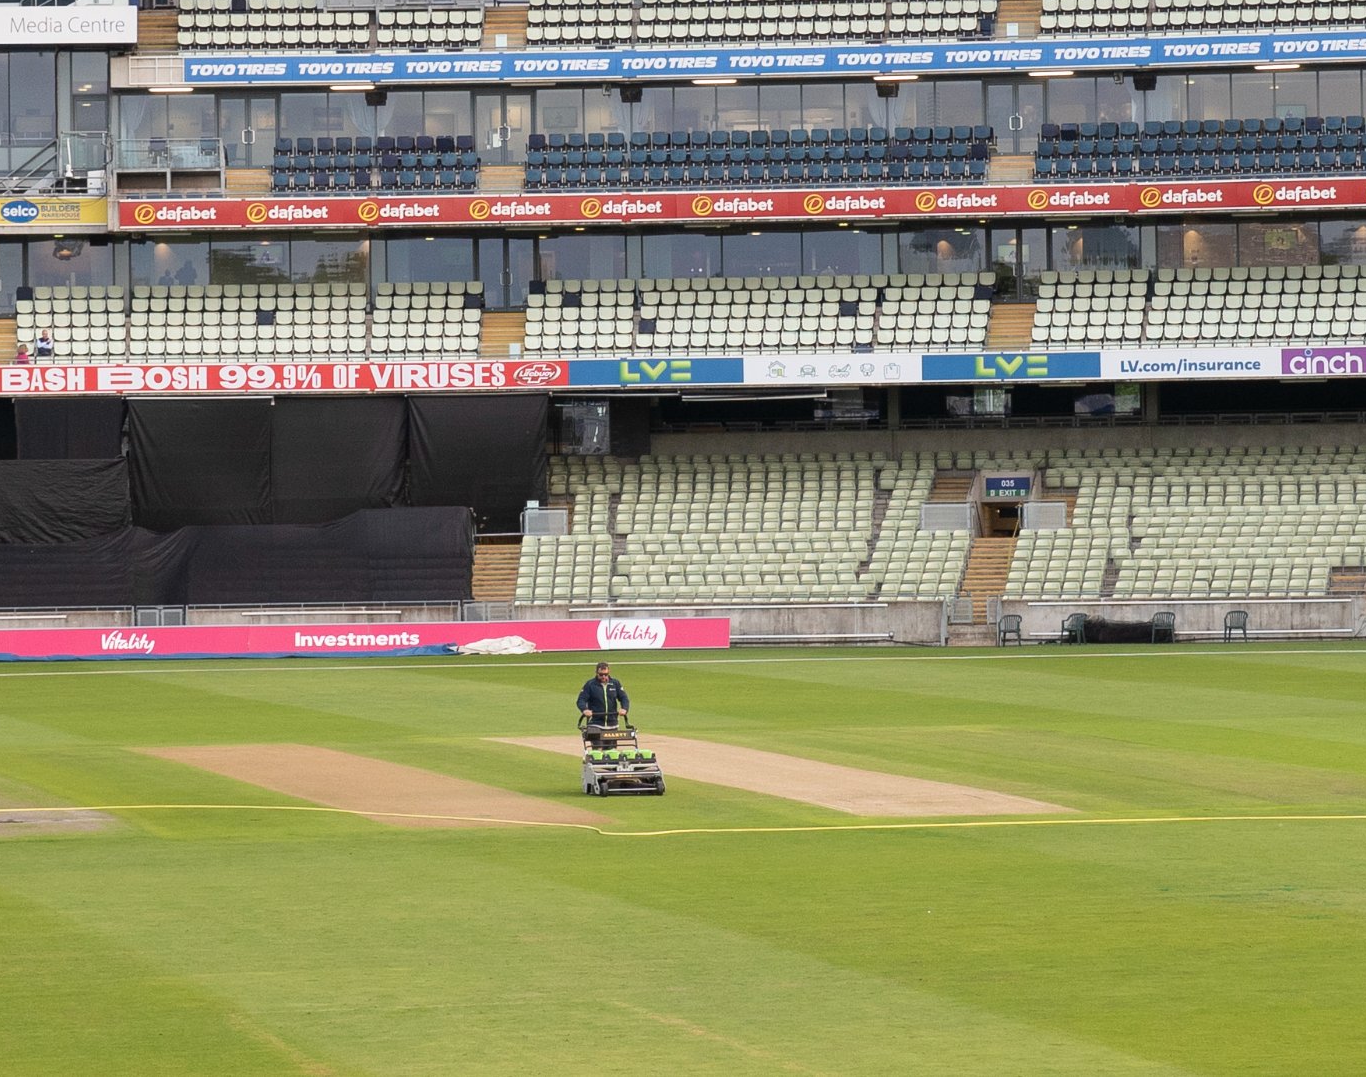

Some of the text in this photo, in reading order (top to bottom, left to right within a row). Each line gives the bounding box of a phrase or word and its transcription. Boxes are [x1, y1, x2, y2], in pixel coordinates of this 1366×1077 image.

[11, 17, 62, 33] Media
[68, 17, 125, 33] Centre
[191, 64, 236, 75] TOYO
[237, 64, 286, 75] TIRES
[299, 63, 343, 74] TOYO
[346, 62, 394, 74] TIRES
[406, 61, 451, 73] TOYO
[453, 60, 502, 72] TIRES
[514, 60, 559, 71] TOYO
[561, 59, 610, 70] TIRES
[622, 58, 667, 69] TOYO
[669, 57, 717, 68] TIRES
[730, 56, 774, 67] TOYO
[776, 55, 825, 66] TIRES
[838, 53, 883, 65] TOYO
[885, 52, 933, 64] TIRES
[946, 50, 991, 62] TOYO
[993, 49, 1042, 61] TIRES
[1054, 48, 1100, 59] TOYO
[1102, 46, 1151, 58] TIRES
[1164, 44, 1209, 56] TOYO
[1211, 42, 1261, 54] TIRES
[1273, 41, 1319, 52] TOYO
[2, 206, 37, 218] selco
[157, 206, 216, 222] dafabet
[268, 205, 328, 221] dafabet
[380, 203, 439, 219] dafabet
[491, 202, 550, 217] dafabet
[603, 200, 662, 215] dafabet
[714, 198, 773, 213] dafabet
[826, 196, 885, 211] dafabet
[937, 193, 997, 209] dafabet
[1050, 191, 1109, 207] dafabet
[1162, 189, 1222, 205] dafabet
[1276, 186, 1336, 202] dafabet
[1120, 359, 1261, 375] LV.com/insurance
[1290, 348, 1363, 374] cinch
[2, 368, 85, 391] BASH
[97, 366, 207, 390] BOSH
[219, 365, 321, 389] 99.9%
[333, 364, 364, 388] OF
[369, 363, 505, 388] VIRUSES
[101, 630, 154, 654] Vitality
[295, 631, 420, 648] Investments
[605, 624, 658, 645] Vitality
